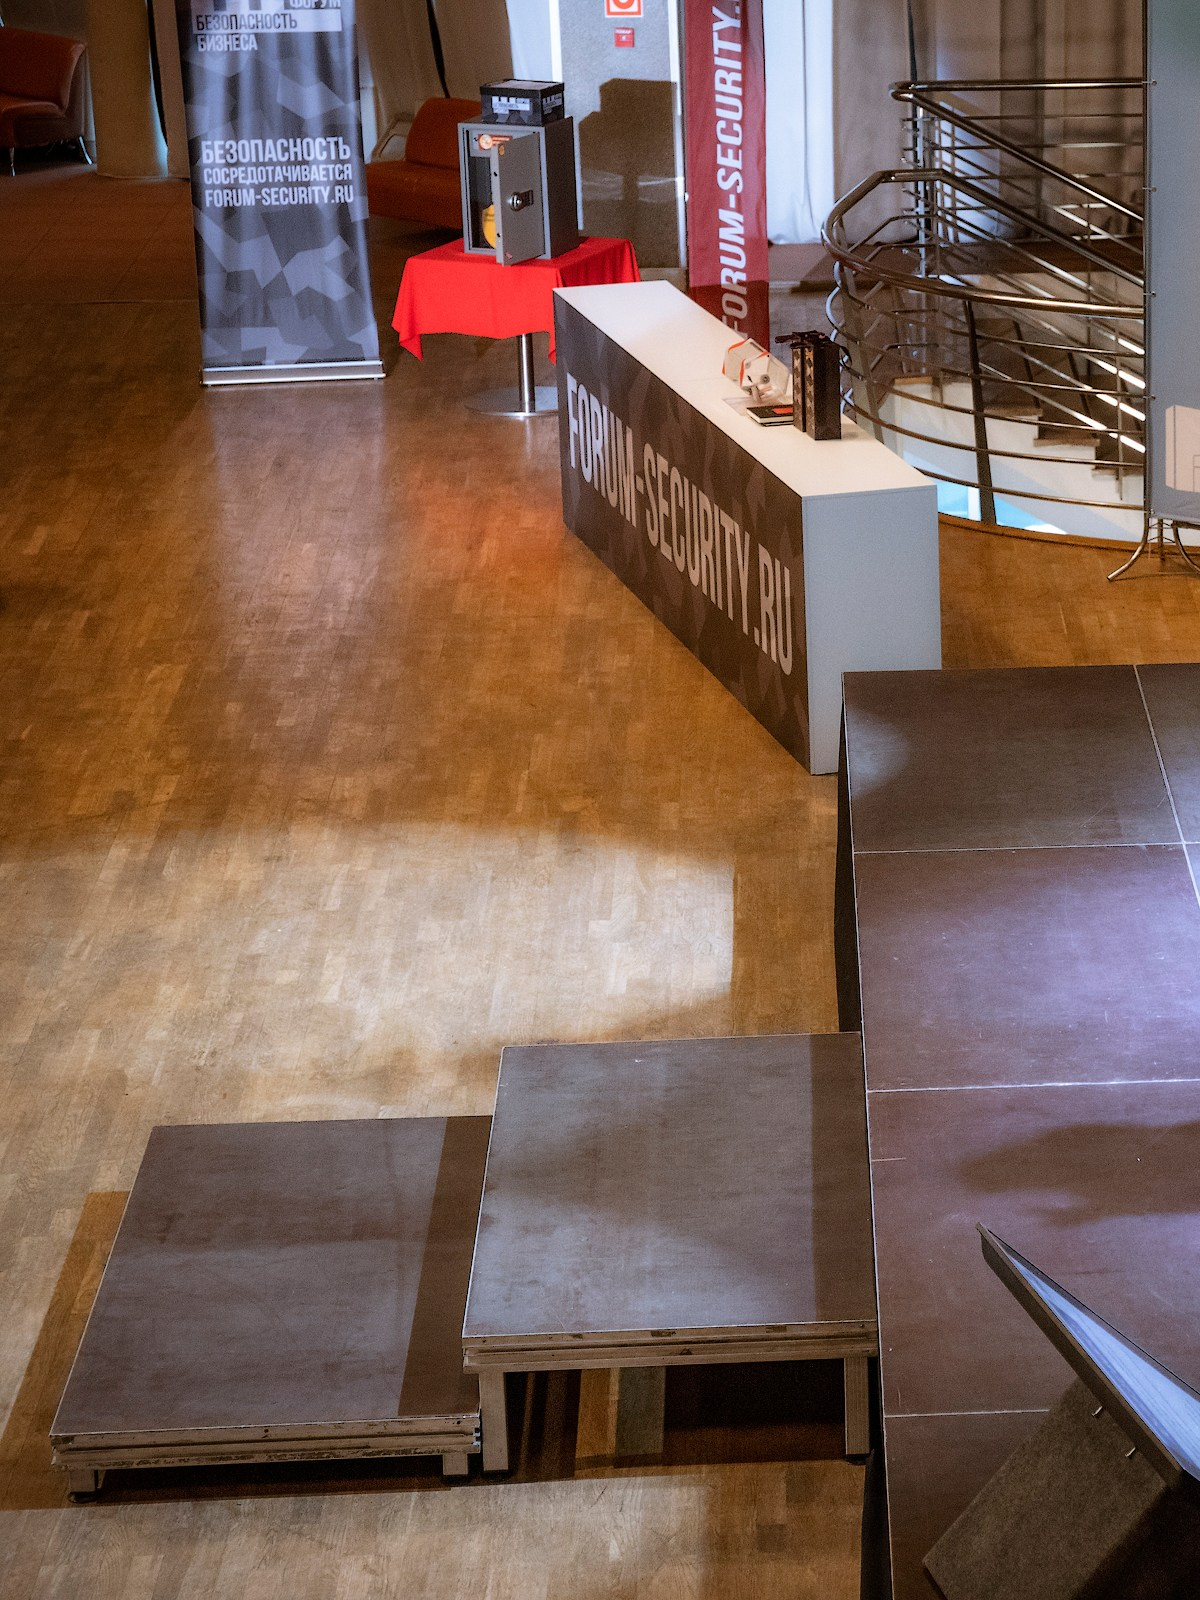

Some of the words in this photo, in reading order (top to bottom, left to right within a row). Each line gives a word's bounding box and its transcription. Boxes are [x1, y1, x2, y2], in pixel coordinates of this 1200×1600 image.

[196, 13, 298, 31] БЕЗОПАСНОСТЬ
[198, 33, 258, 51] БИЗНЕСА
[201, 136, 351, 165] БЕЗОПАСНОСТЬ
[203, 163, 353, 186] СОСРЕДОТАЧИВАЕТСЯ
[205, 186, 354, 207] FORUM-SECURITY.RU
[567, 371, 793, 676] FORUM-SECURITY.RU
